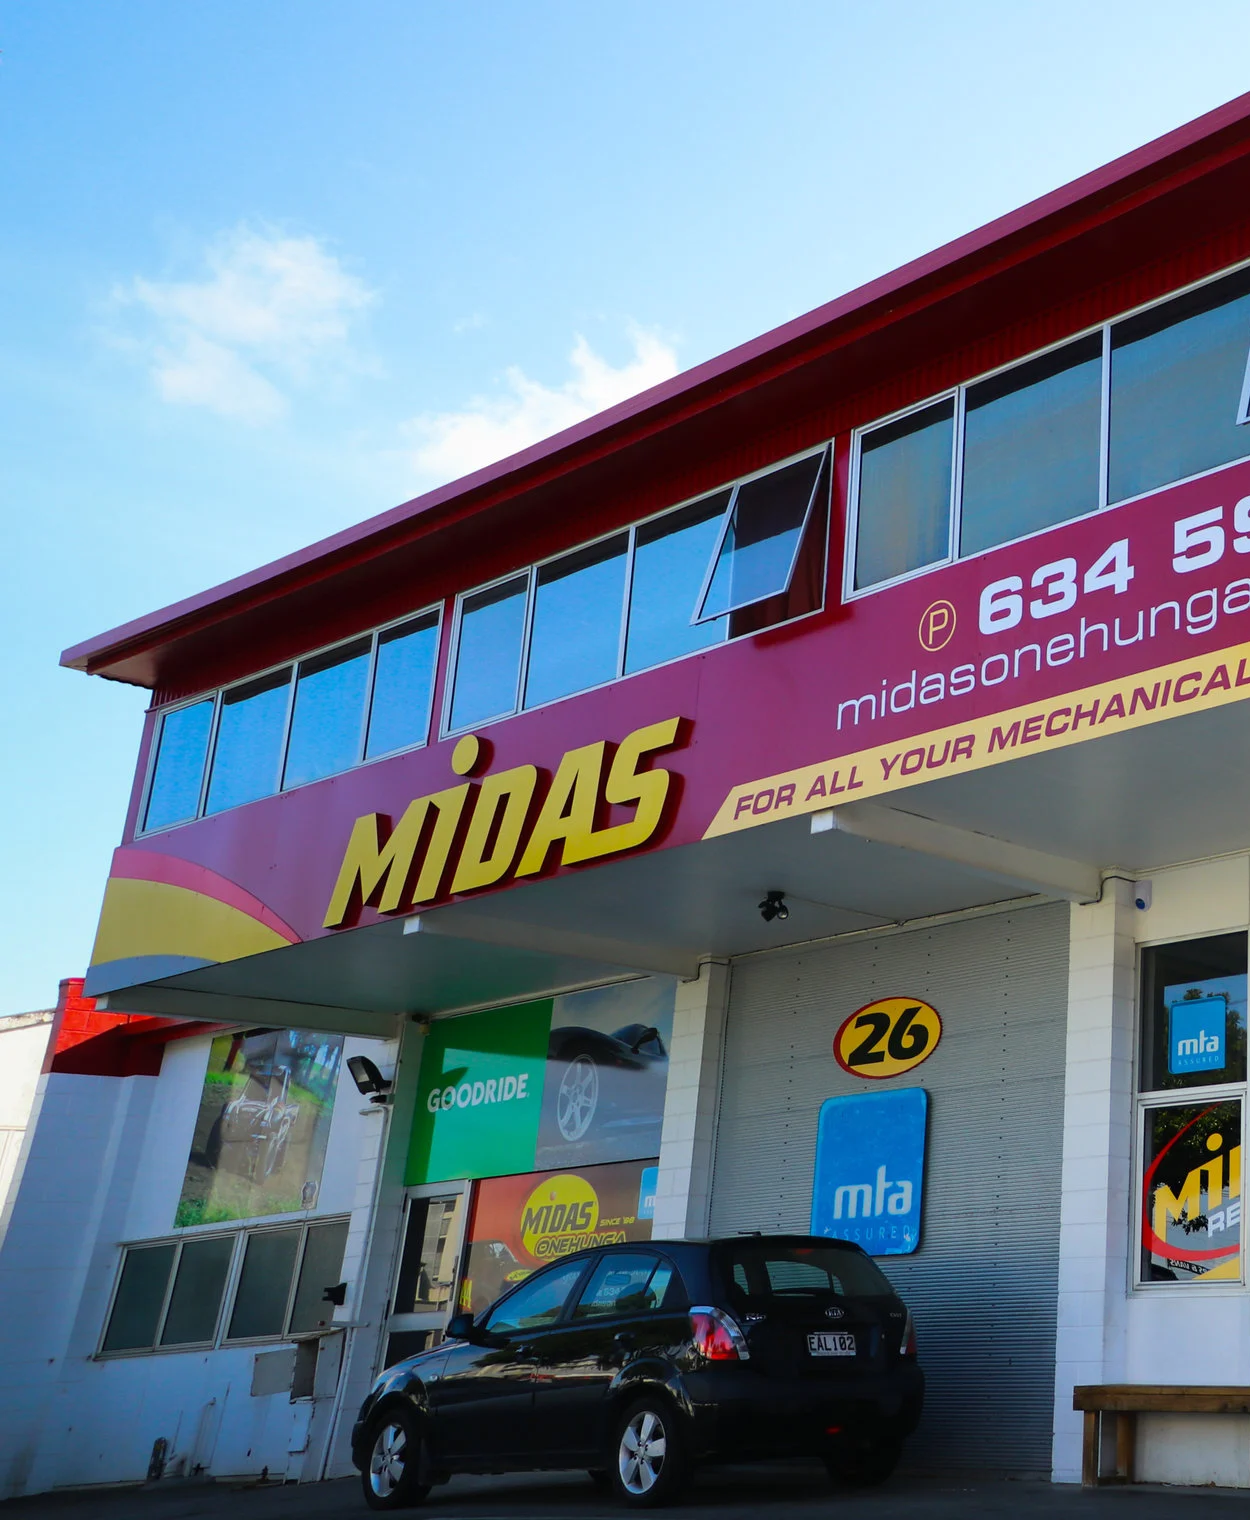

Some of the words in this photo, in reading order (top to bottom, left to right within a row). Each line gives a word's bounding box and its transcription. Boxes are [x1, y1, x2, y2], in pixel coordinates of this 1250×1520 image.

[978, 538, 1134, 635] 634
[732, 782, 796, 821] FOR
[803, 765, 865, 801] ALL
[880, 733, 975, 781] YOUR
[848, 1005, 929, 1067] 26
[1177, 1029, 1219, 1056] mta
[427, 1073, 529, 1114] GOODRIDE
[833, 1165, 913, 1220] mta
[808, 1336, 855, 1351] EAL102
